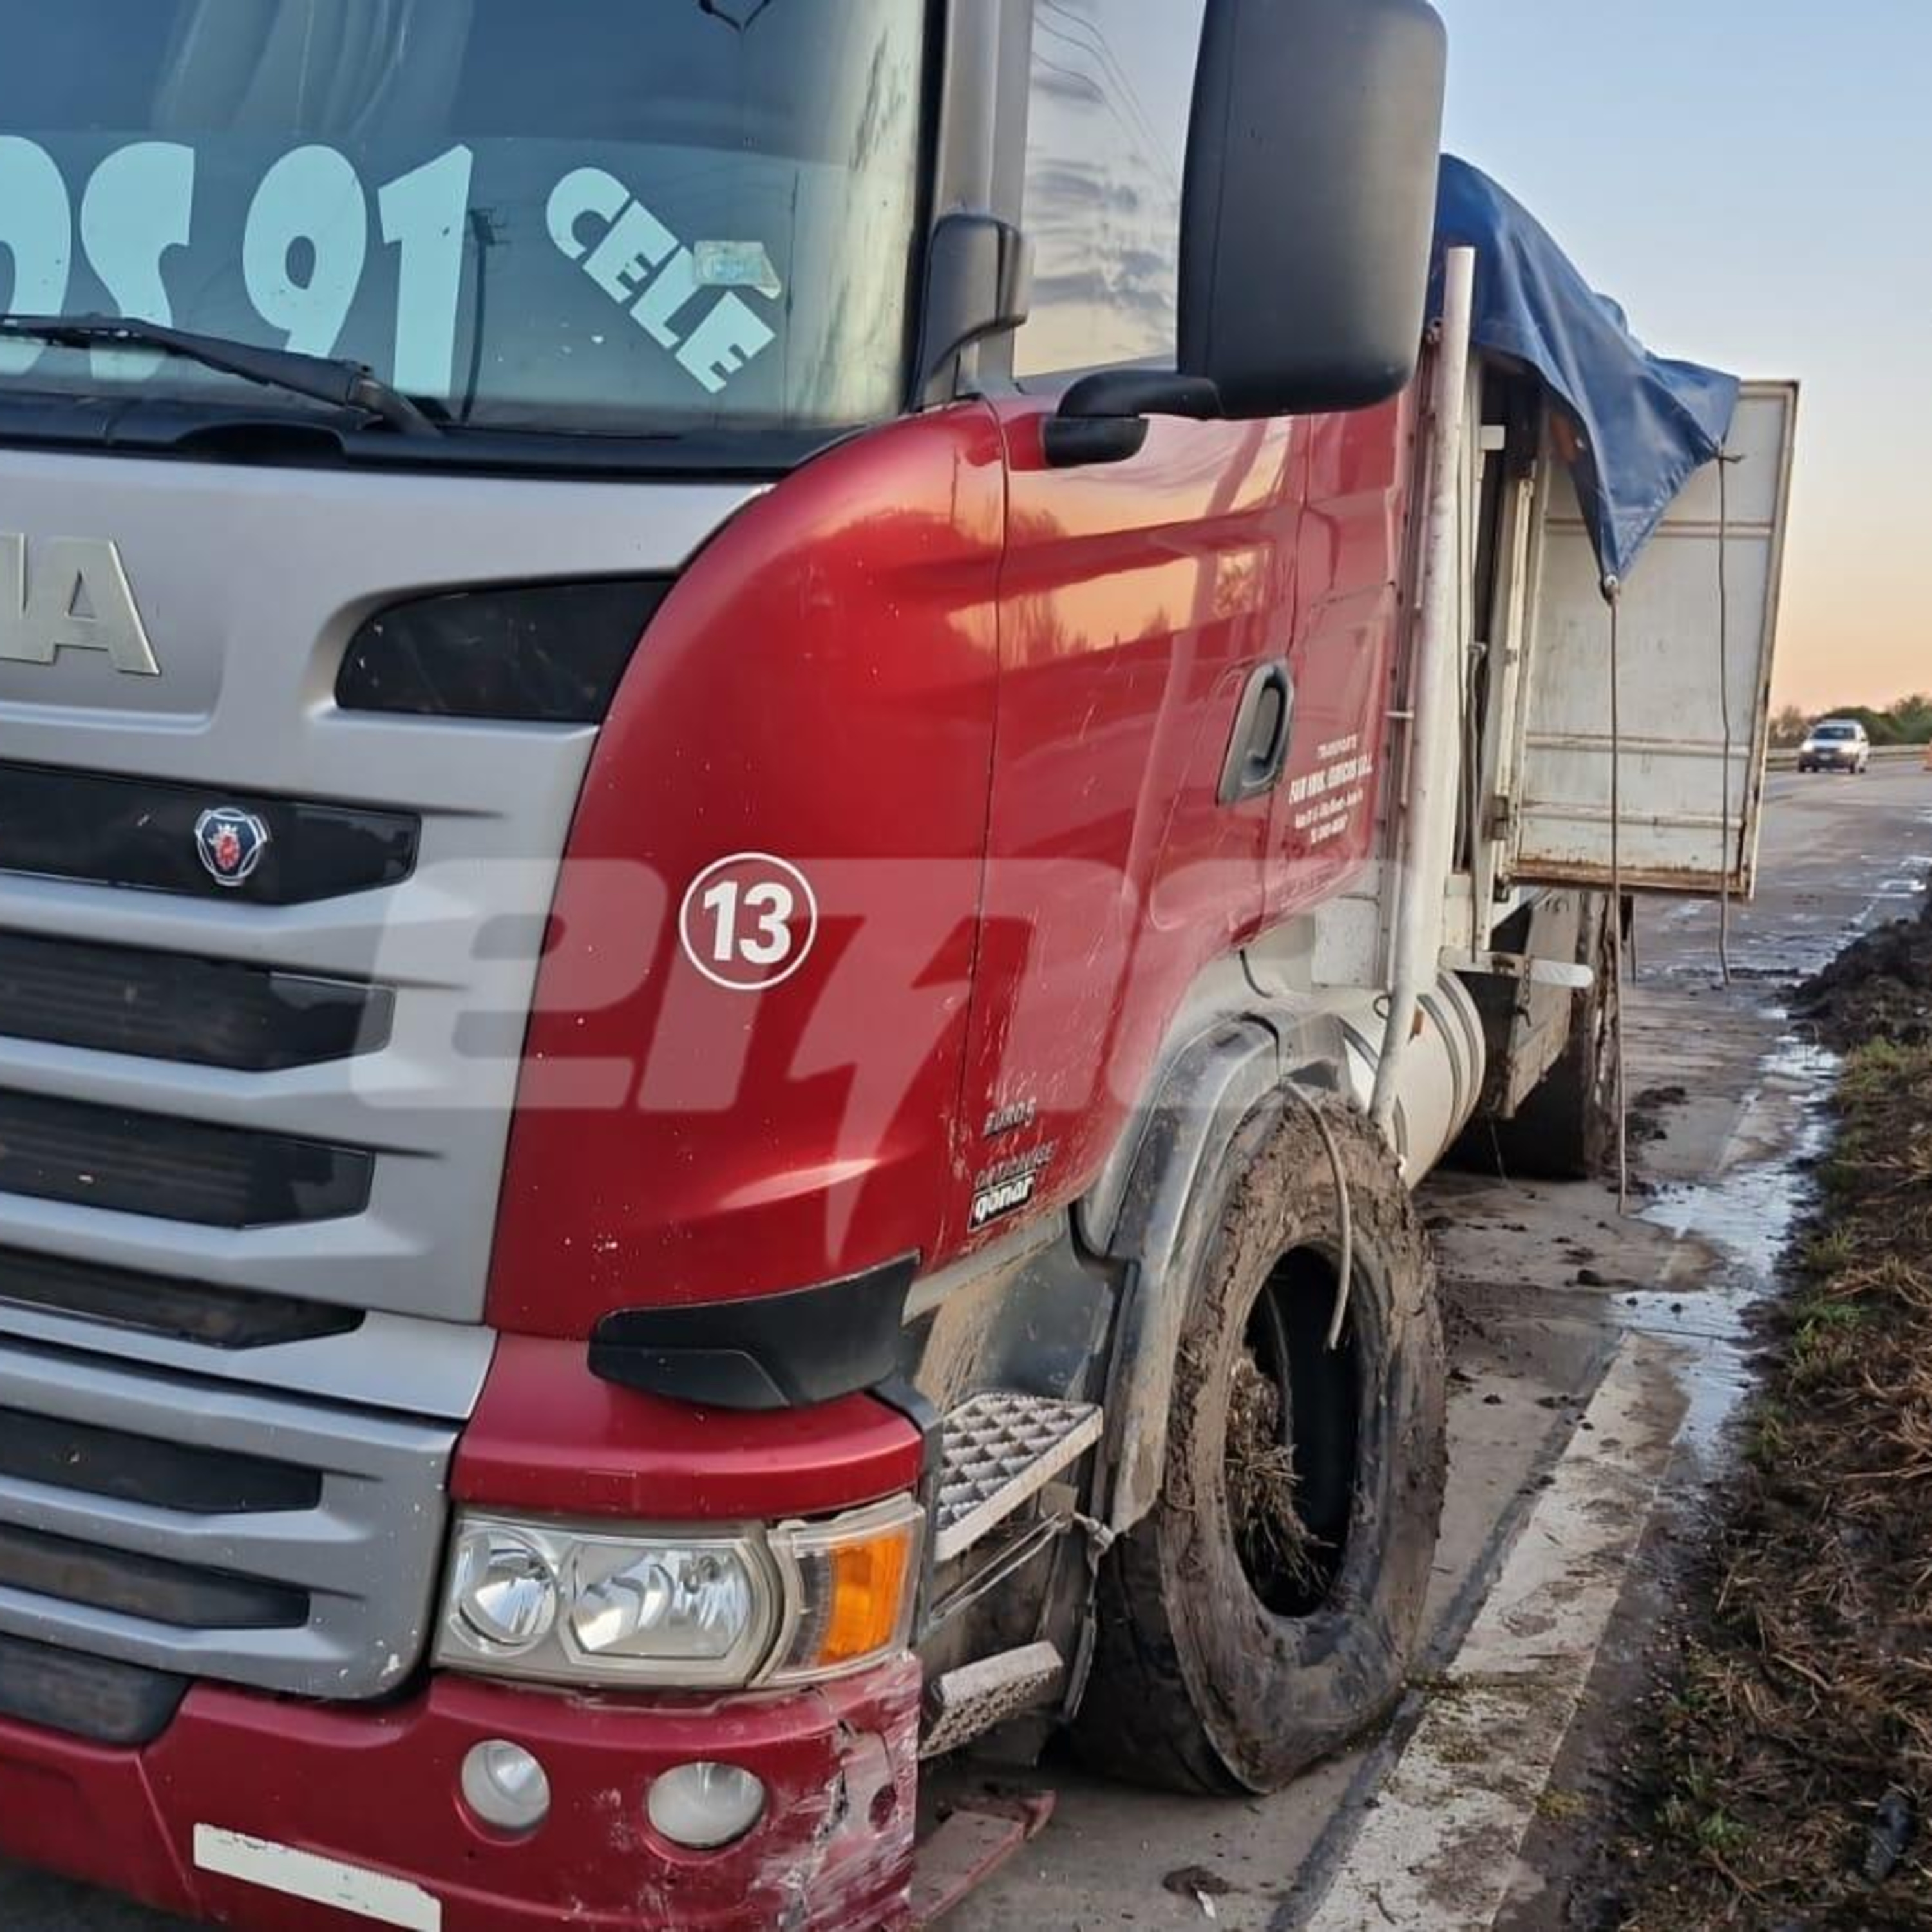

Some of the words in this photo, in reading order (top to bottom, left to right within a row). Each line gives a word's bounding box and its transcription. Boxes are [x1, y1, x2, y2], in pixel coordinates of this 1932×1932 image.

[243, 144, 473, 398] 91
[546, 167, 775, 393] CELE
[704, 880, 793, 963] 13
